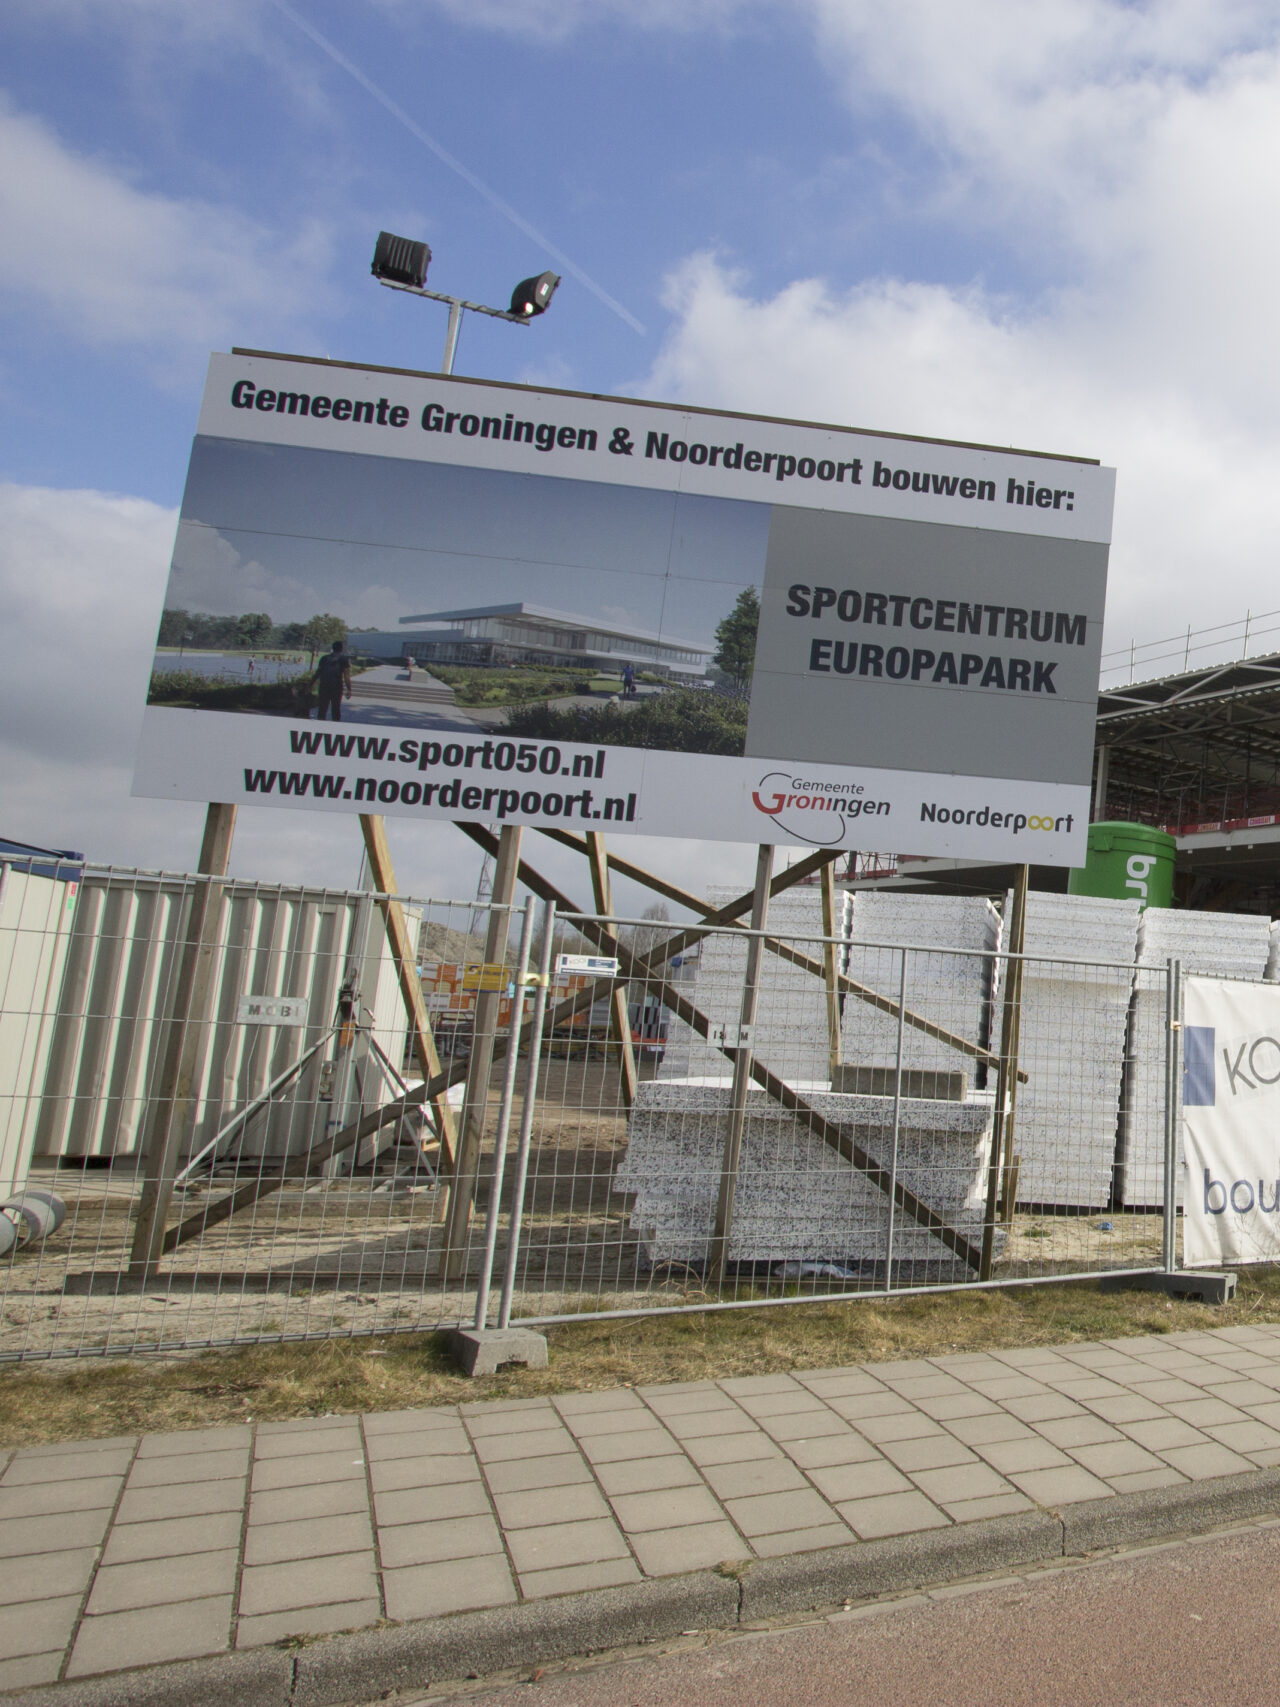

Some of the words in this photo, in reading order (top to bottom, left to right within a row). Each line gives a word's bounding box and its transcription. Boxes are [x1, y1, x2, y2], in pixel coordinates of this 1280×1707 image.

[230, 379, 410, 429] Gemeente
[420, 403, 599, 453] Groningen
[607, 426, 635, 456] &
[644, 431, 863, 485] Noorderpoort
[872, 461, 997, 501] bouwen
[1006, 478, 1076, 511] hier:
[785, 583, 1088, 647] SPORTCENTRUM
[808, 638, 1060, 694] EUROPAPARK
[289, 730, 607, 779] www.sport050.nl
[243, 768, 638, 823] www.noorderpoort.nl
[752, 790, 892, 818] Groningen
[791, 778, 865, 796] Gemeente
[919, 802, 1075, 834] Noorderpoort
